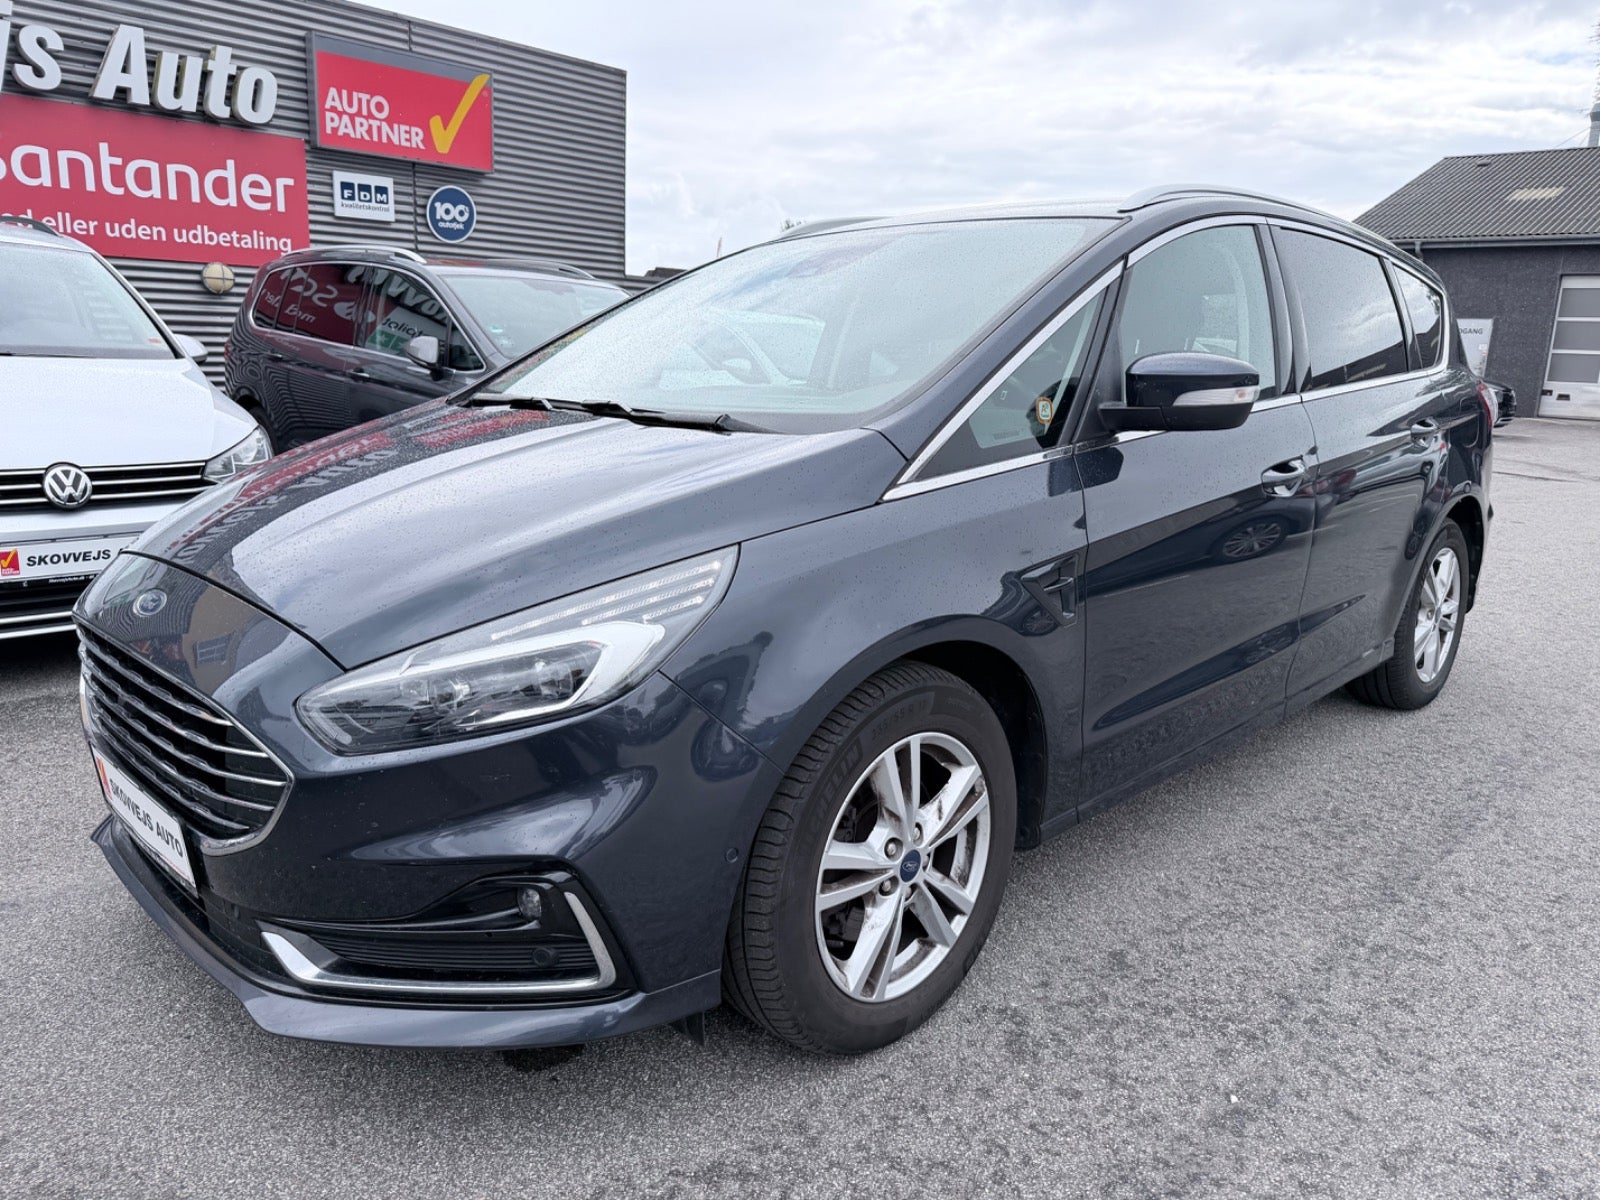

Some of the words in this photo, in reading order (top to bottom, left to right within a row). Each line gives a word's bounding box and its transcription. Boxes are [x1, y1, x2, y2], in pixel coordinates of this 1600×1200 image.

[91, 24, 278, 124] Auto
[325, 86, 390, 119] AUTO
[325, 111, 426, 150] PARTNER
[343, 189, 388, 203] FDM
[42, 211, 98, 235] eller
[105, 219, 166, 241] uden
[173, 225, 292, 254] udbetaling
[26, 549, 111, 567] SKOVVEJS
[109, 778, 153, 832] SKOVVEJS
[156, 821, 183, 858] AUTO
